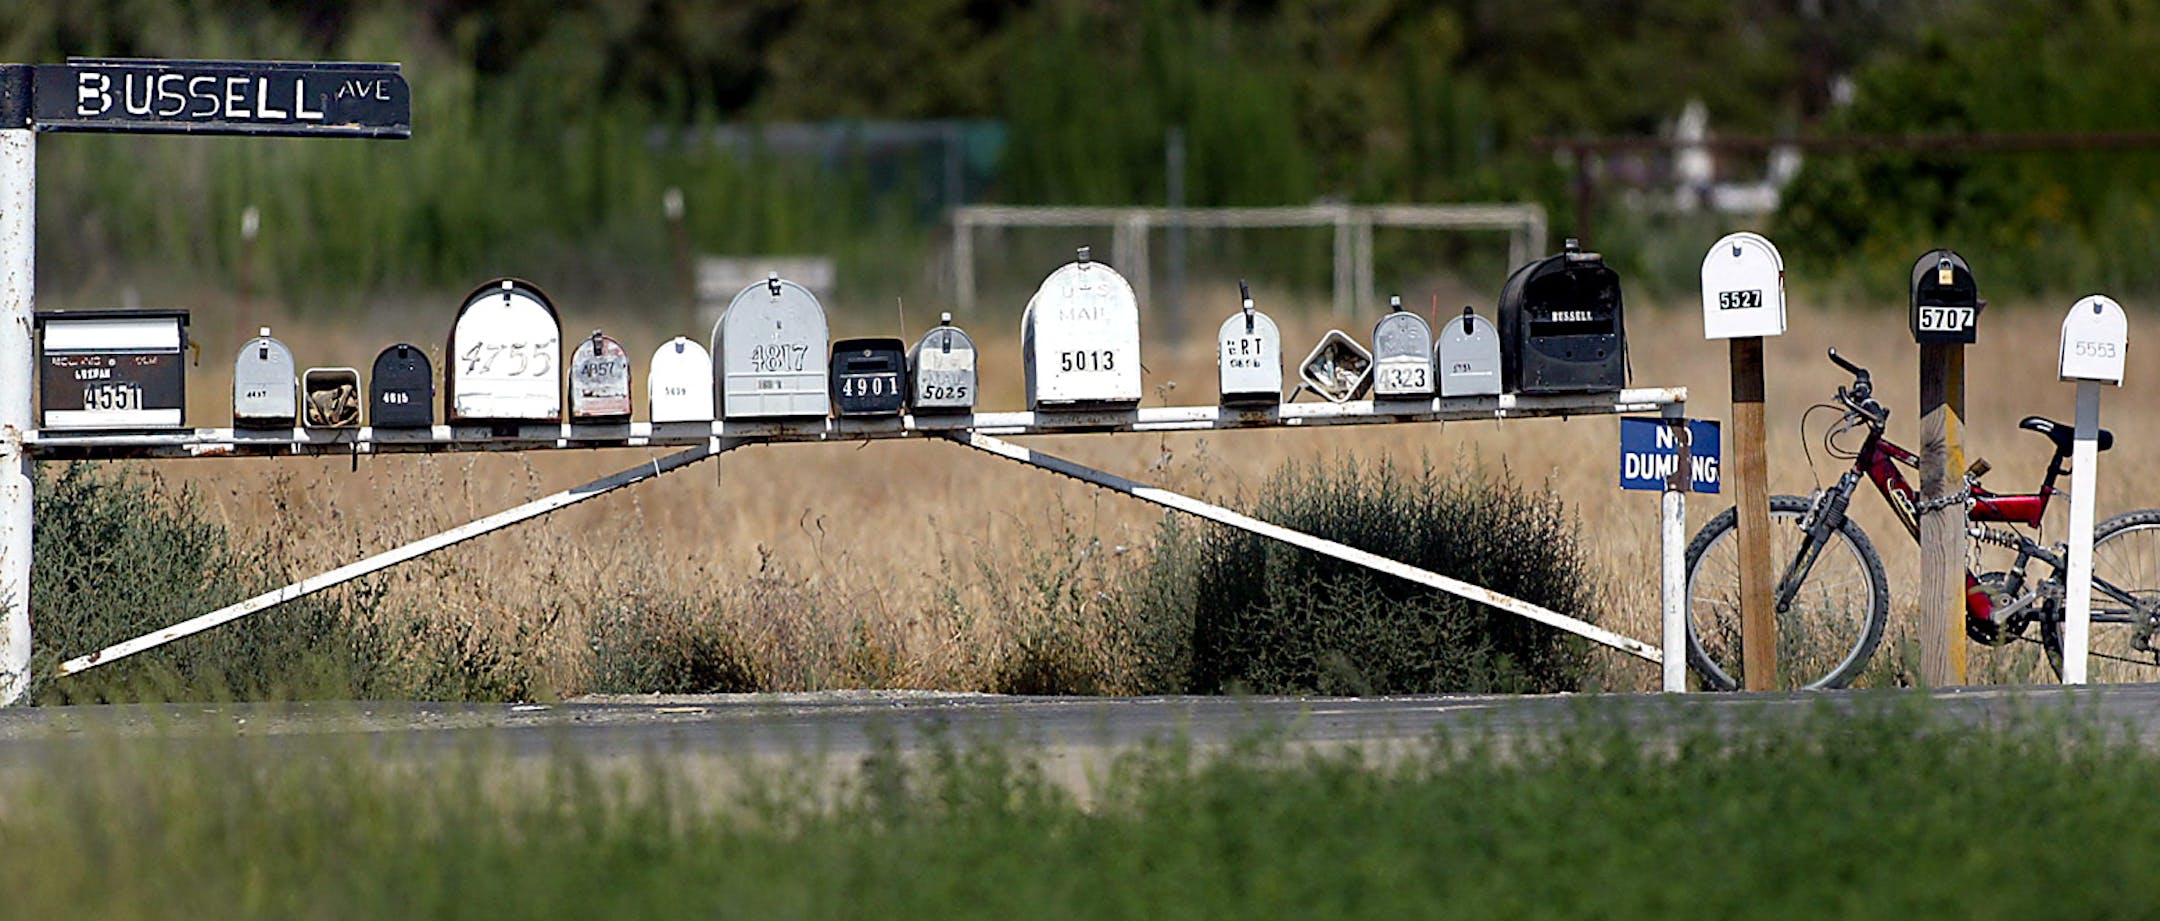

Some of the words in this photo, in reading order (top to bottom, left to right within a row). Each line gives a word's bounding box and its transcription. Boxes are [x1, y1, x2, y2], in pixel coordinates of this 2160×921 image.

[77, 72, 324, 120] BUSSELL
[337, 80, 390, 101] AVE
[1721, 290, 1761, 309] 5527
[1922, 308, 1971, 328] 5707
[461, 340, 556, 377] 4755
[751, 343, 808, 373] 4817
[2076, 340, 2116, 359] 5553
[1062, 350, 1114, 372] 5013
[842, 376, 898, 397] 4901
[1380, 368, 1425, 388] 4323
[85, 383, 140, 410] 4551
[923, 385, 968, 400] 5025
[1625, 452, 1719, 483] DUMNG
